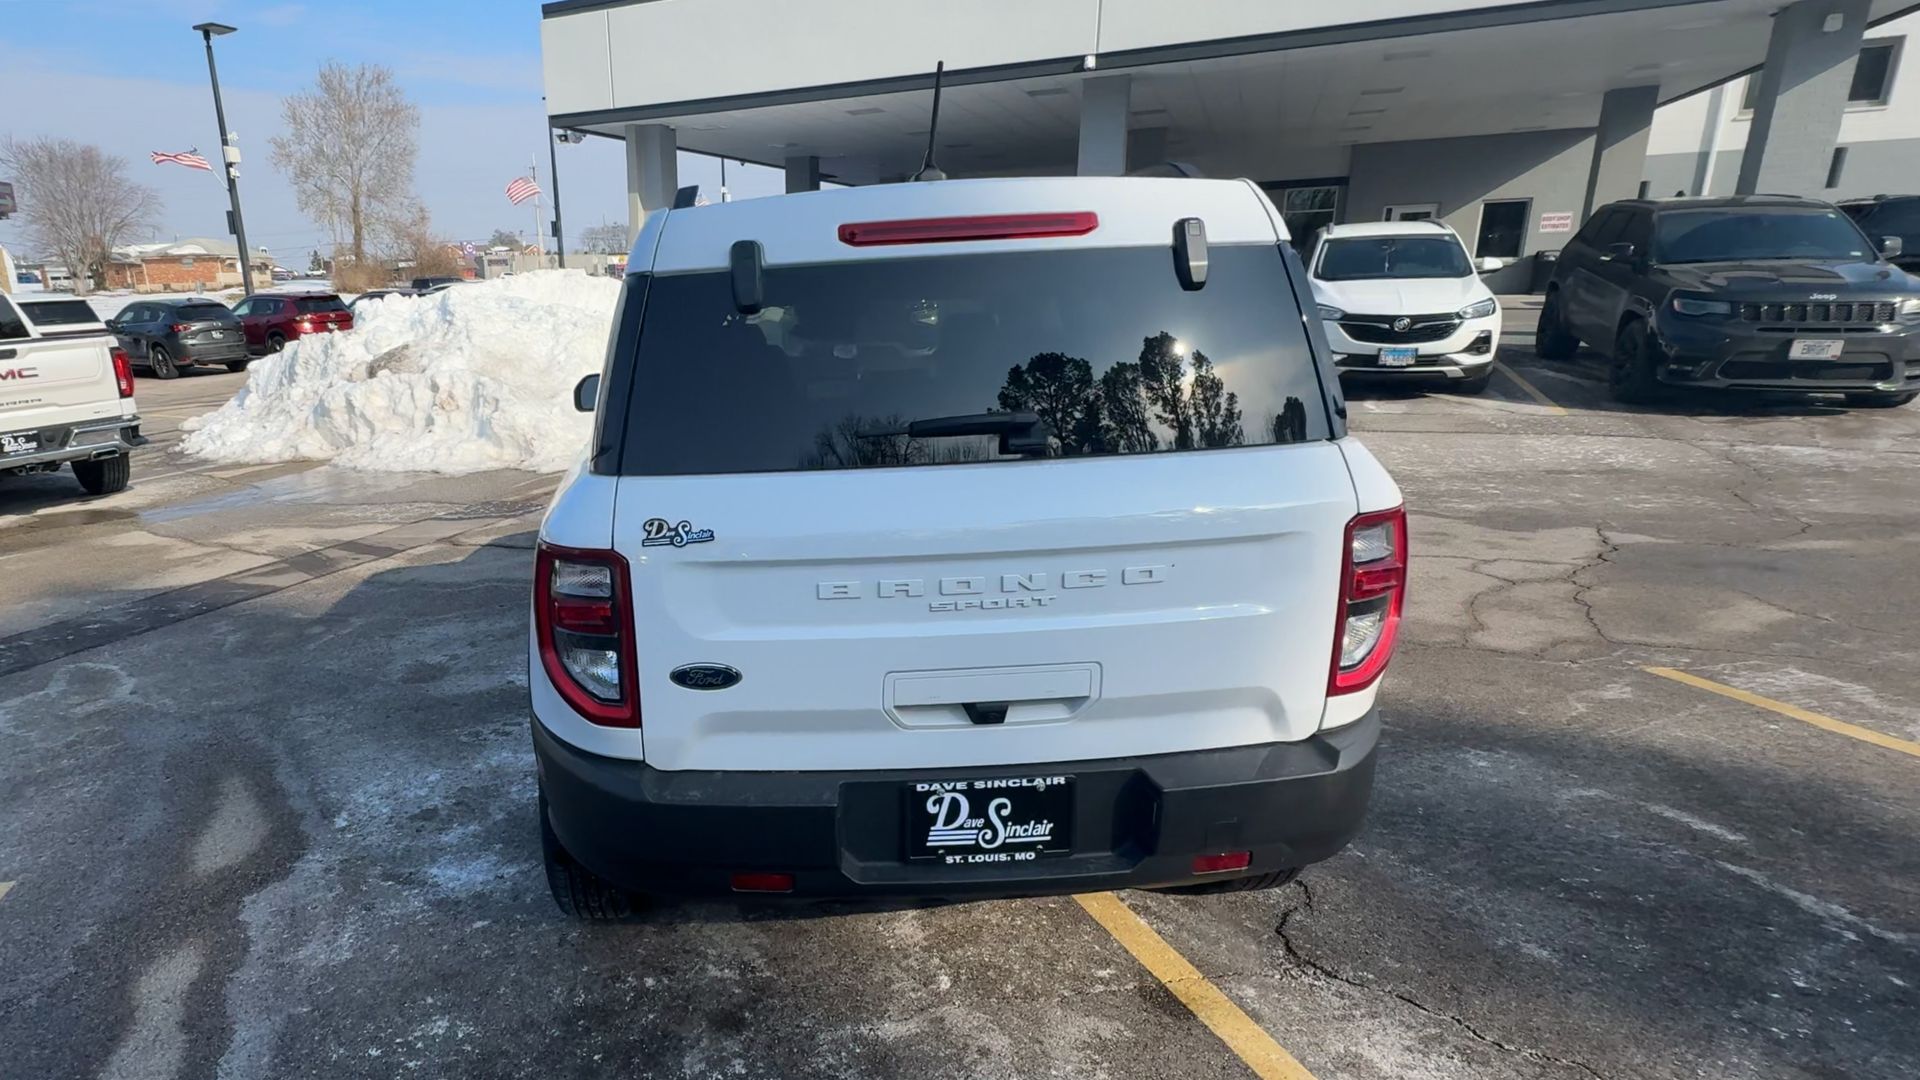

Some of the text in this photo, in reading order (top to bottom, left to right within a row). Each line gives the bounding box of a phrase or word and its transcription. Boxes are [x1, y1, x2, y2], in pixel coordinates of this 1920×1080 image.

[1809, 293, 1838, 301] Jeep
[0, 366, 39, 380] MC
[643, 519, 713, 546] Dave Sinclair
[816, 564, 1166, 600] BRONCO
[928, 595, 1057, 612] SPORT
[686, 668, 725, 686] Ford
[916, 776, 1067, 792] DAVE SINCLAIR
[926, 792, 1054, 849] Dave Sinclair
[945, 851, 1036, 864] ST. LOUIS, MO
